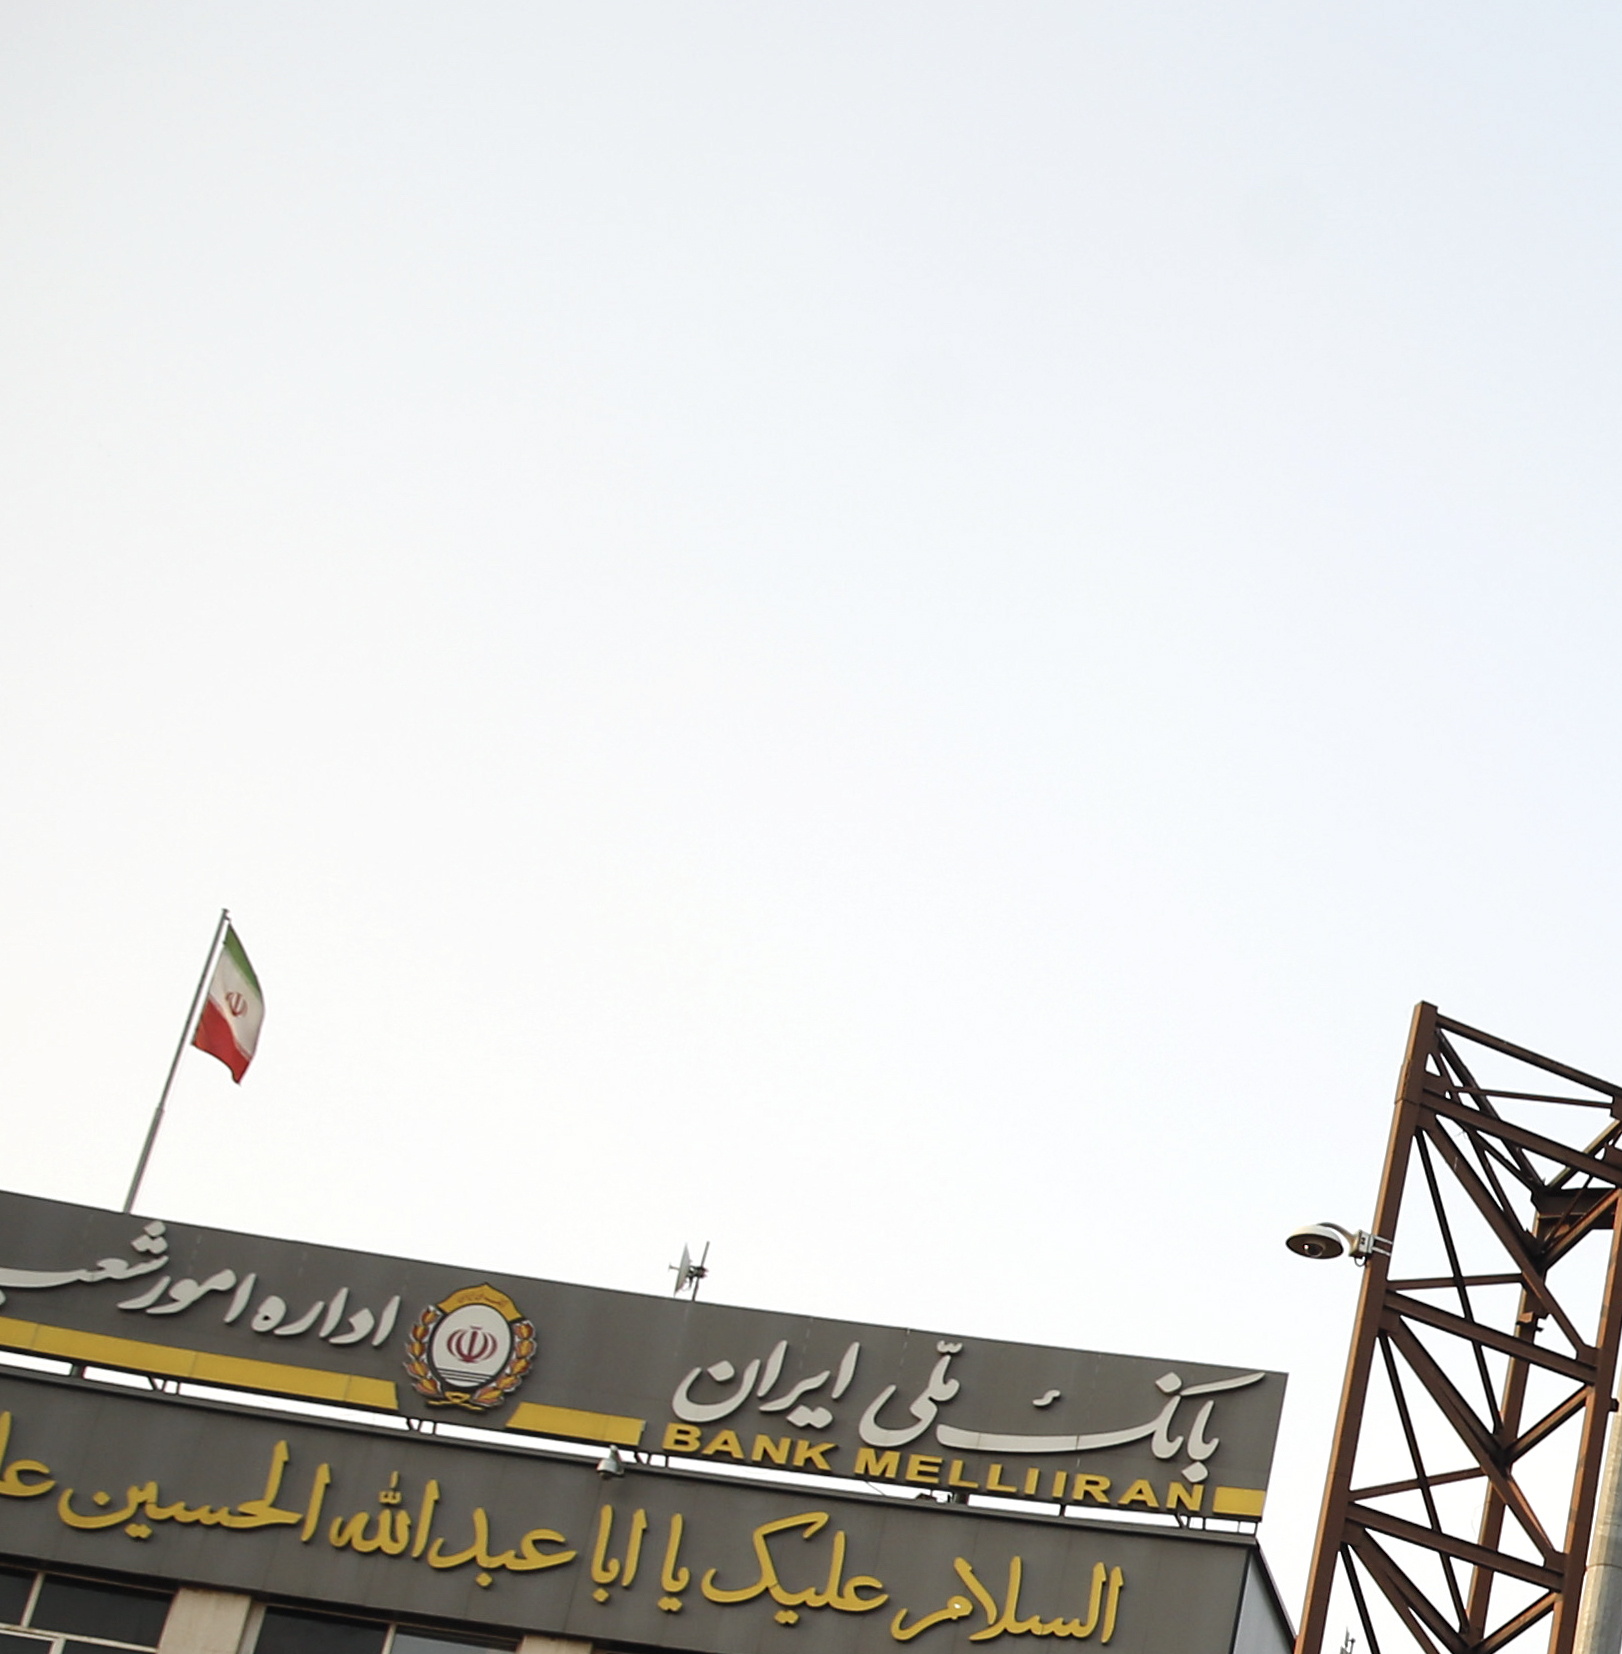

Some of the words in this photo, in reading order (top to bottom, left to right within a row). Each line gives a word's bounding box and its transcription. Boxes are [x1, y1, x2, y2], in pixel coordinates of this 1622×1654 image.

[117, 1269, 256, 1324] امور
[251, 1287, 399, 1346] اداره
[672, 1339, 860, 1429] ایران
[662, 1423, 839, 1471] BANK
[855, 1448, 1039, 1498] MELLI
[1052, 1470, 1205, 1512] IRAN
[890, 1556, 1123, 1643] السلام
